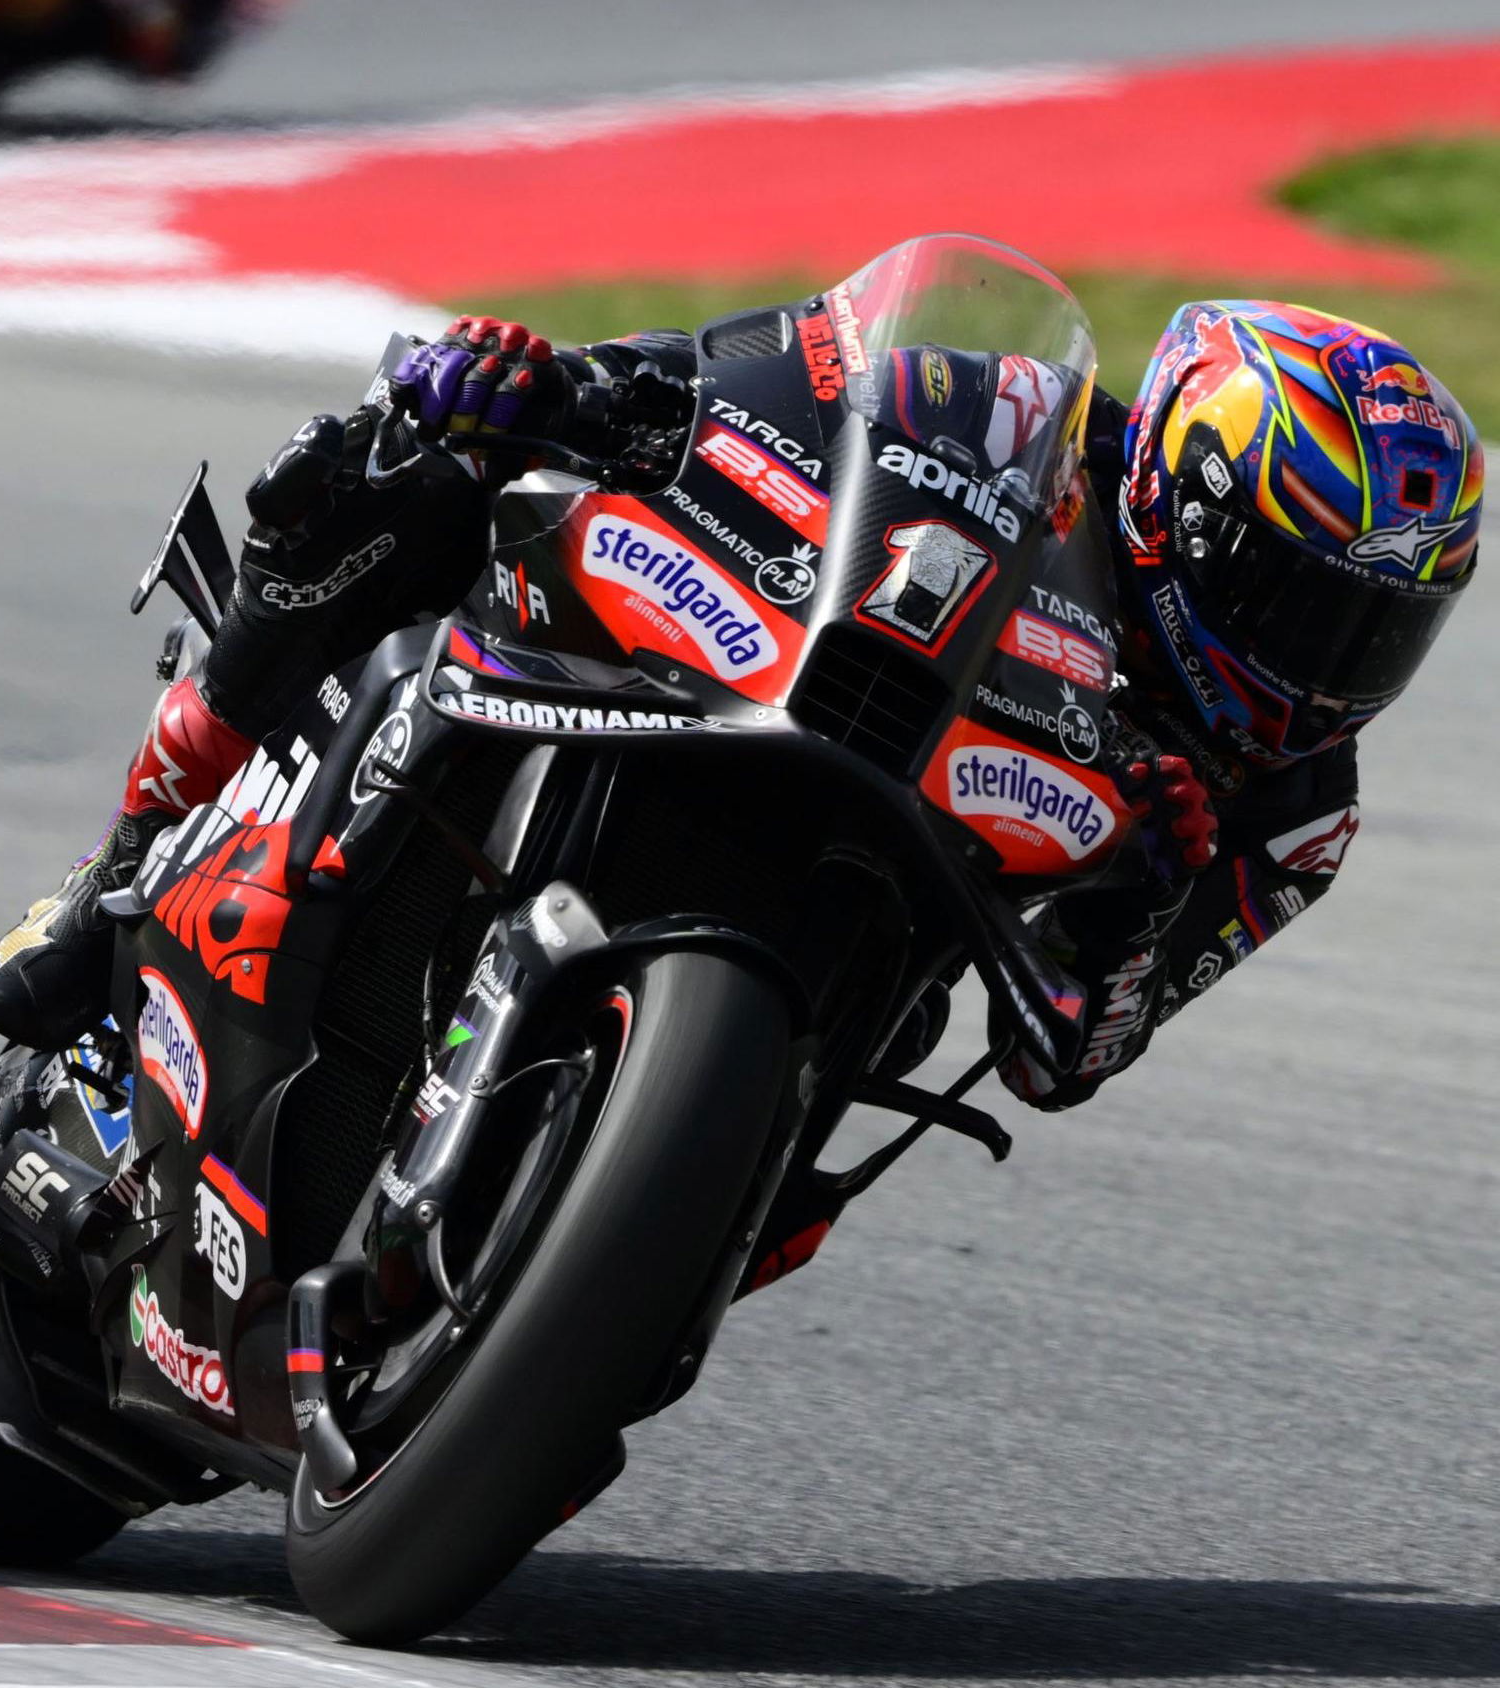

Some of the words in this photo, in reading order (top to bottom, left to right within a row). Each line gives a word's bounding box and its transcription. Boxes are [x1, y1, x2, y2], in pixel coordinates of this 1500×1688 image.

[708, 398, 824, 481] TARGA
[1356, 395, 1420, 426] Red
[701, 431, 822, 517] BS
[877, 443, 1021, 544] aprilia
[1205, 460, 1229, 492] 100%
[261, 532, 397, 611] alpinestars
[664, 486, 764, 567] PRAGMATIC
[761, 563, 808, 598] PLAY
[592, 525, 761, 667] sterilgarda
[1324, 555, 1370, 580] GIVES
[1378, 573, 1409, 590] YOU
[1414, 583, 1453, 596] WINGS
[624, 592, 685, 644] alimenti
[1015, 614, 1106, 681] BS
[1030, 585, 1119, 654] TARGA
[1246, 652, 1282, 687] Breathe
[1280, 678, 1306, 700] Right
[976, 684, 1058, 734] PRAGMATIC
[1062, 722, 1096, 748] PLAY
[956, 754, 1102, 847] sterilgarda
[993, 817, 1046, 848] alimenti
[420, 1072, 461, 1114] SC
[1, 1180, 43, 1224] PROJECT
[5, 1151, 71, 1213] SC
[144, 1291, 236, 1417] Castro
